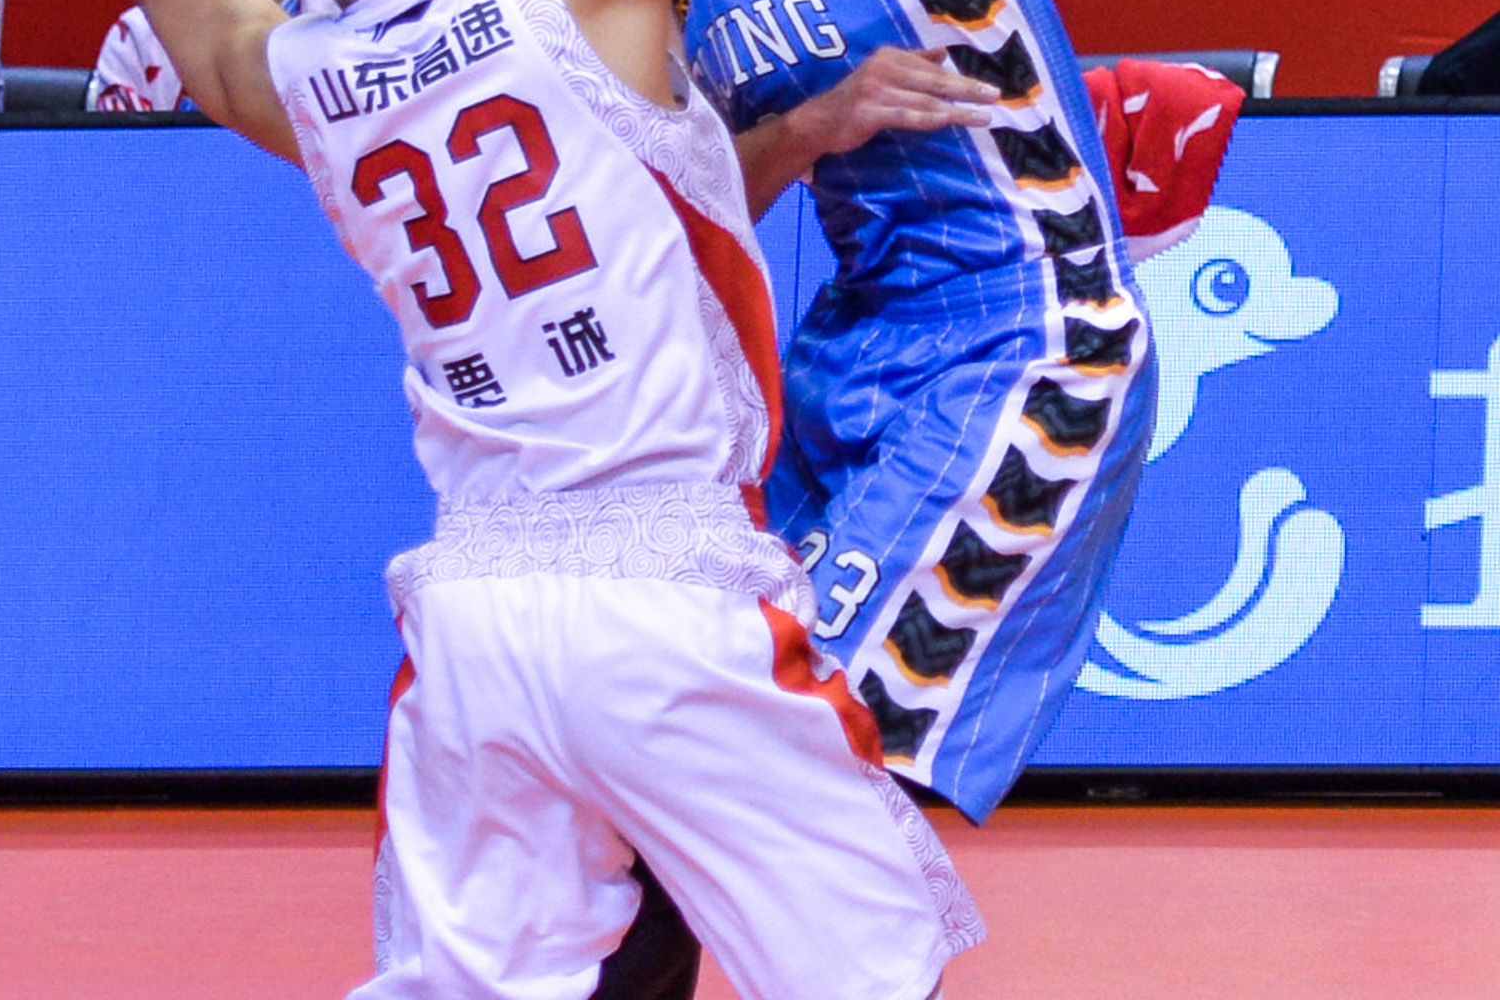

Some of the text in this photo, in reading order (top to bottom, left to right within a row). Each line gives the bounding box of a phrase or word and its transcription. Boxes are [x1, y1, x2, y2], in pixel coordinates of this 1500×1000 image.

[309, 0, 514, 124] 山东高速
[352, 93, 599, 330] 32
